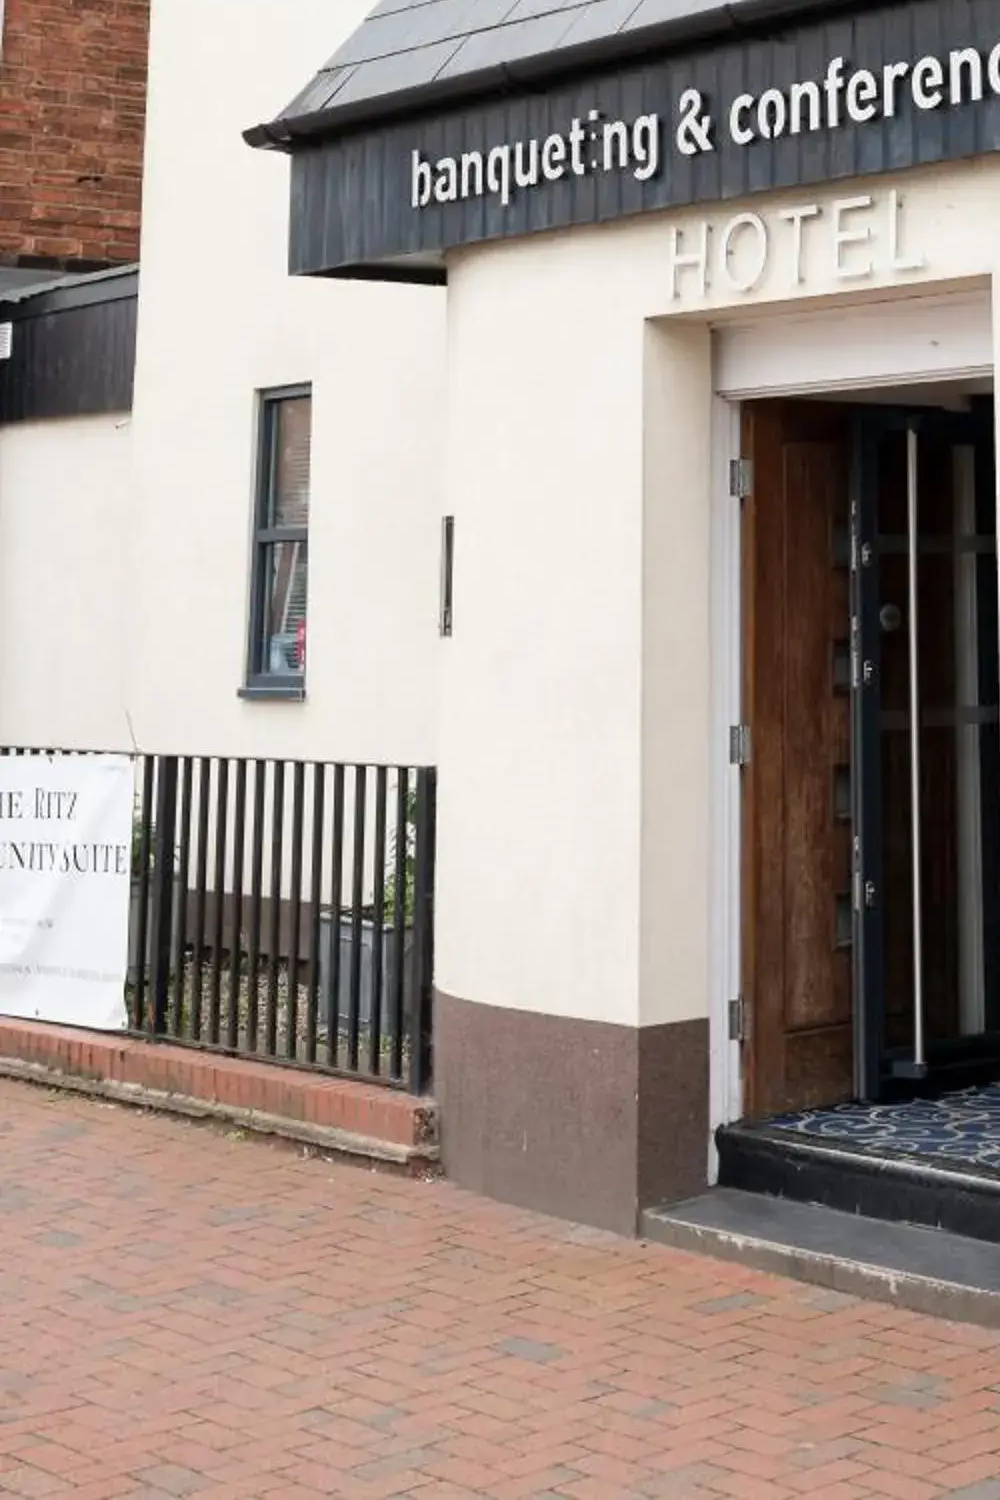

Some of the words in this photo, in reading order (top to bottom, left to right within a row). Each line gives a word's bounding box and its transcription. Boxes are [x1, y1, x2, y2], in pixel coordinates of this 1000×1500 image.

[676, 88, 714, 156] &
[670, 188, 926, 299] HOTEL
[34, 787, 78, 820] RITZ
